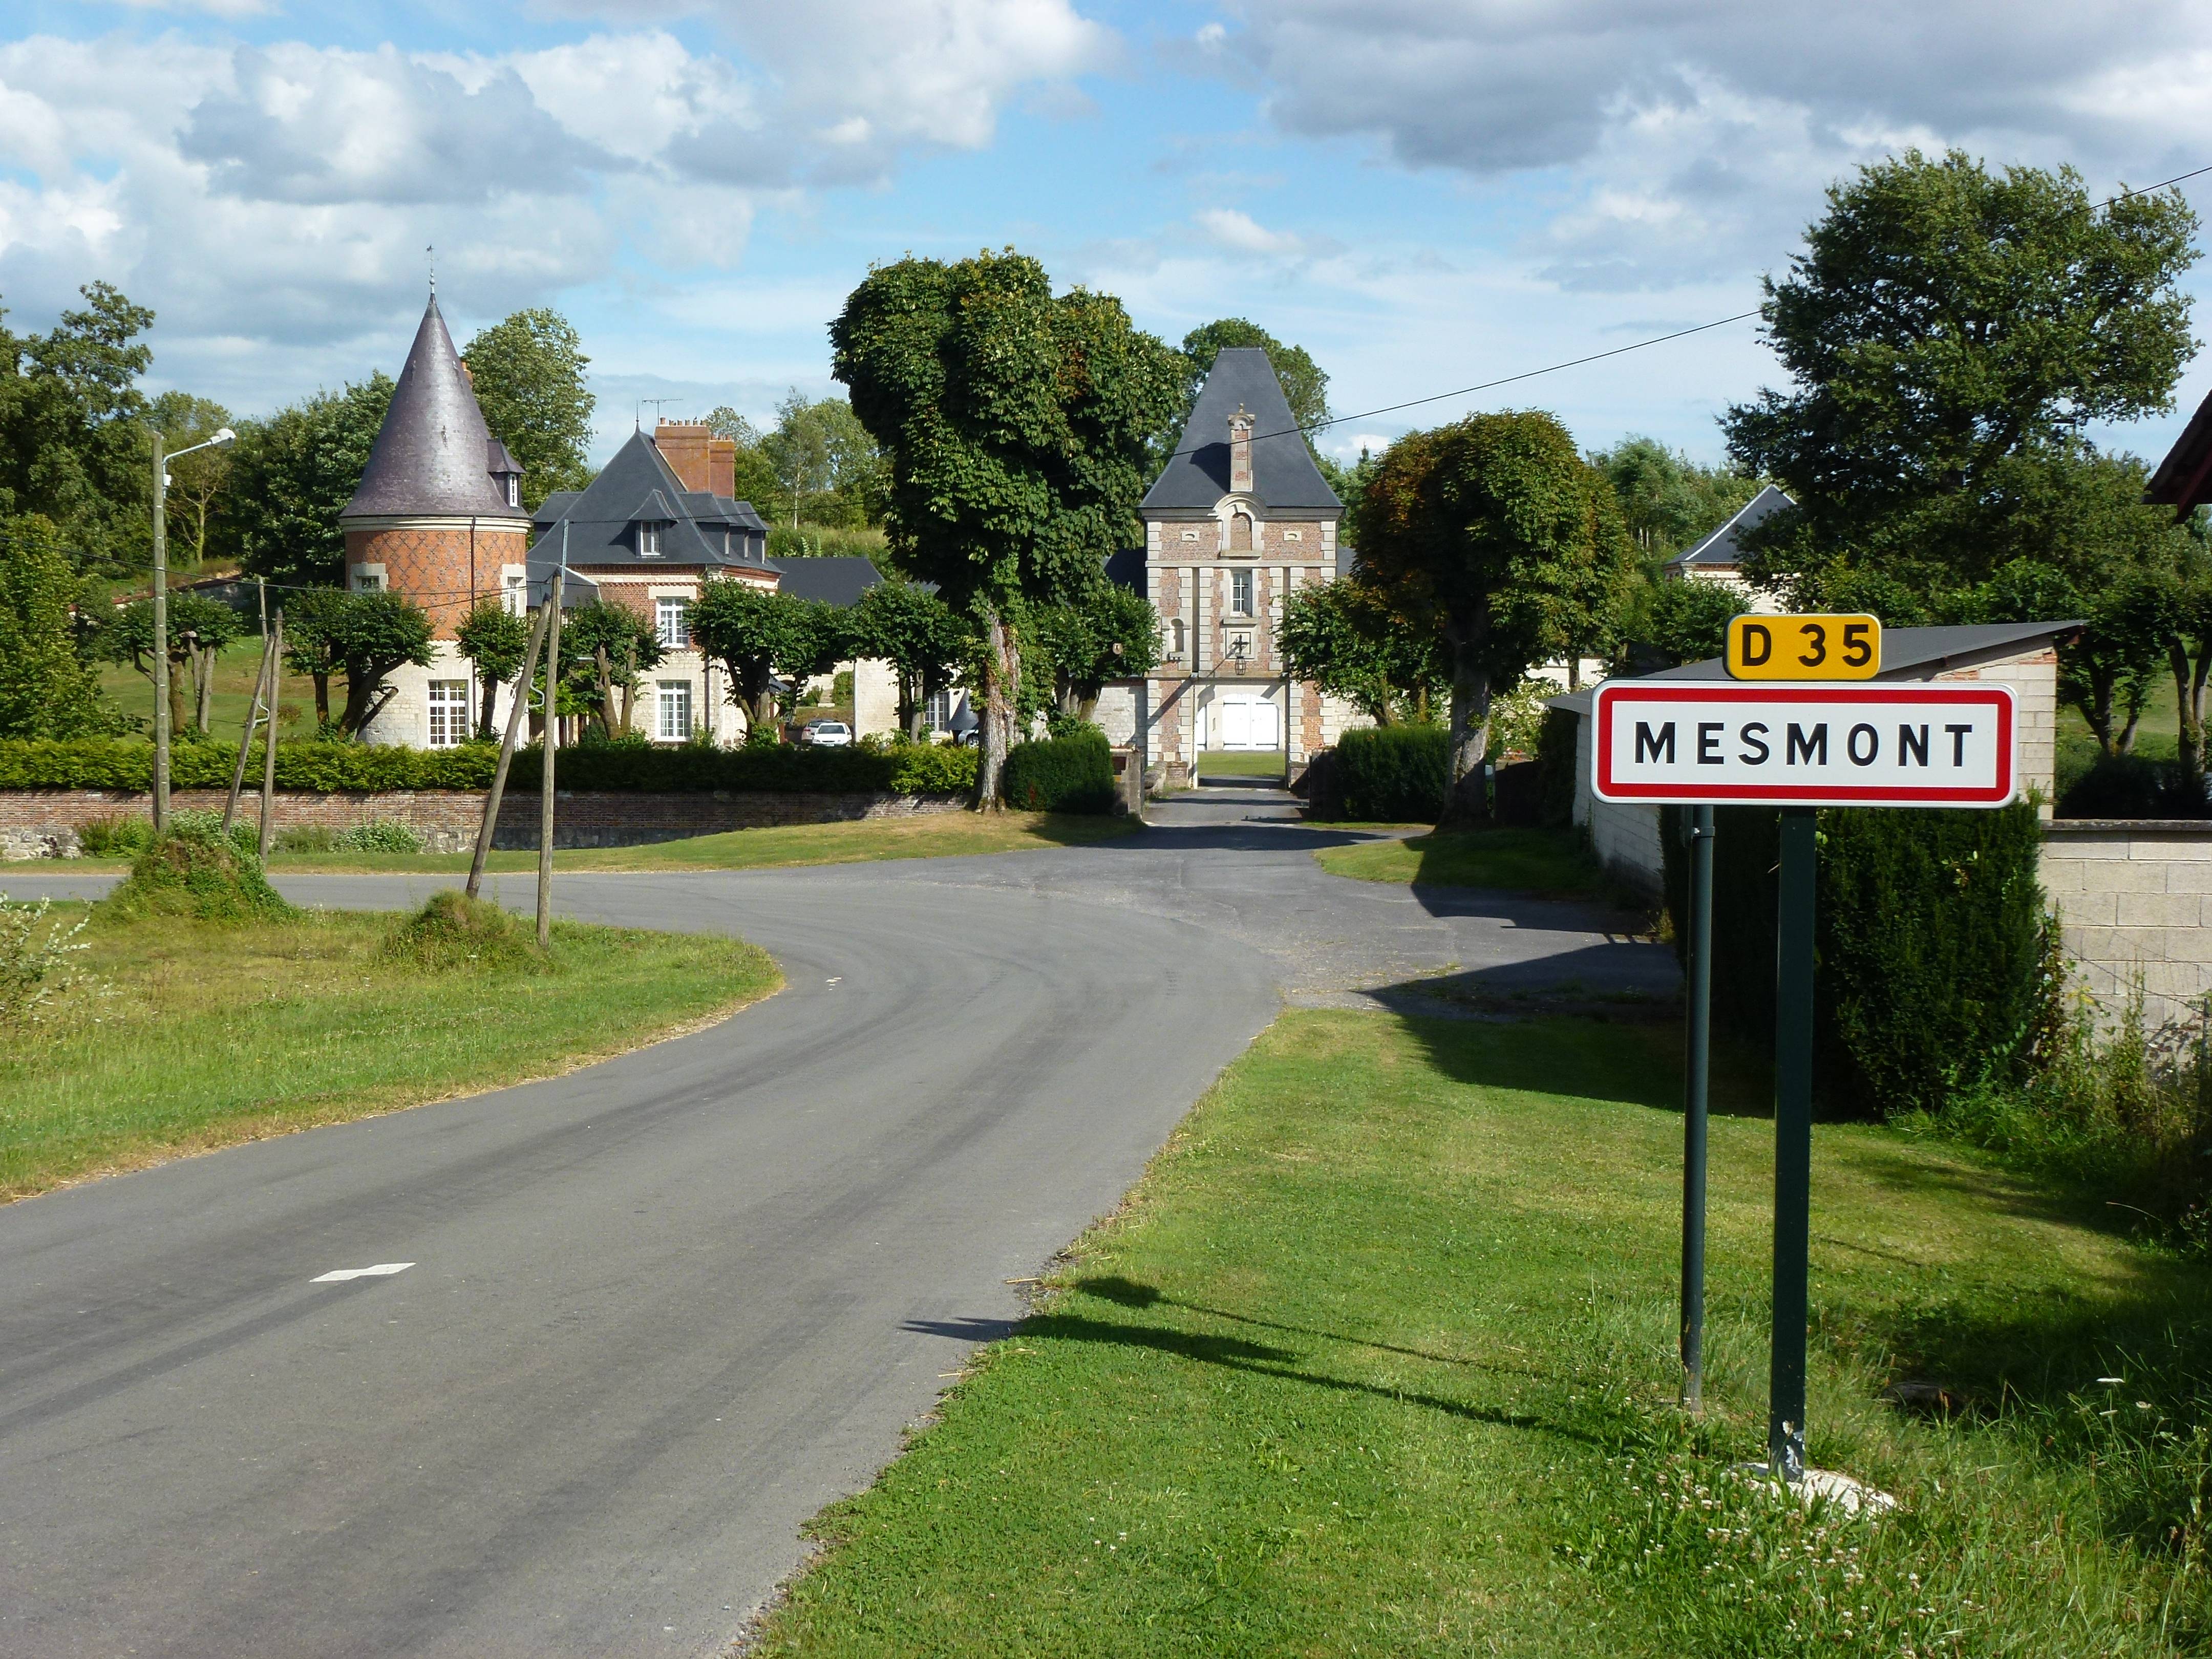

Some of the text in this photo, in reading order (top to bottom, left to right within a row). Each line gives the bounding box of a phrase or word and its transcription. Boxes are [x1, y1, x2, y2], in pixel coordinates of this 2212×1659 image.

[1742, 623, 1871, 667] D 35
[1634, 721, 1973, 767] MESMONT
